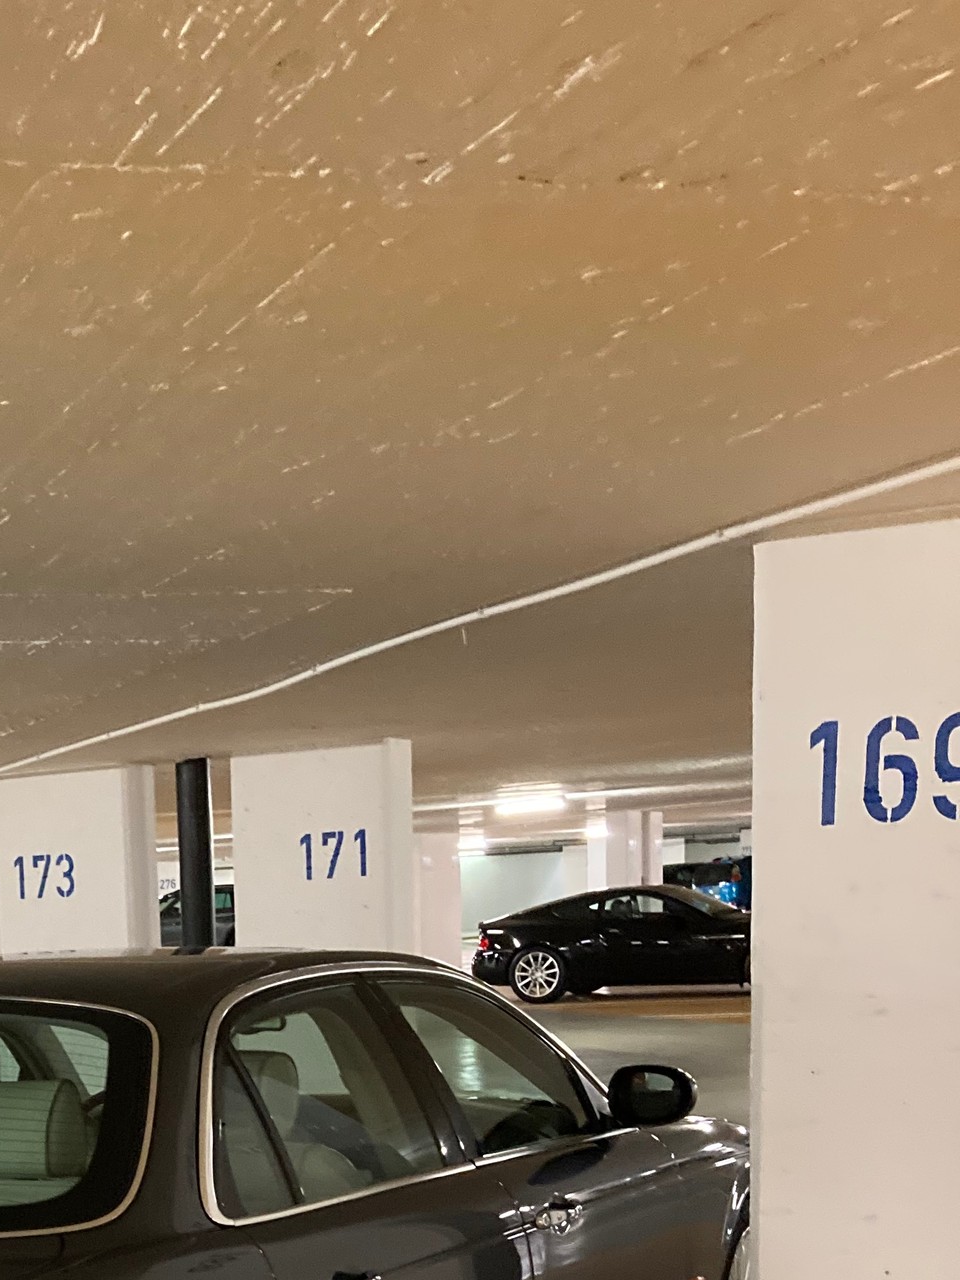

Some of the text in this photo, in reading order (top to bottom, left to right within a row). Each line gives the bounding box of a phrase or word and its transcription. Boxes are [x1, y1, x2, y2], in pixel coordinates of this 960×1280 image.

[14, 853, 75, 900] 173
[300, 828, 367, 880] 171
[160, 879, 176, 890] 276
